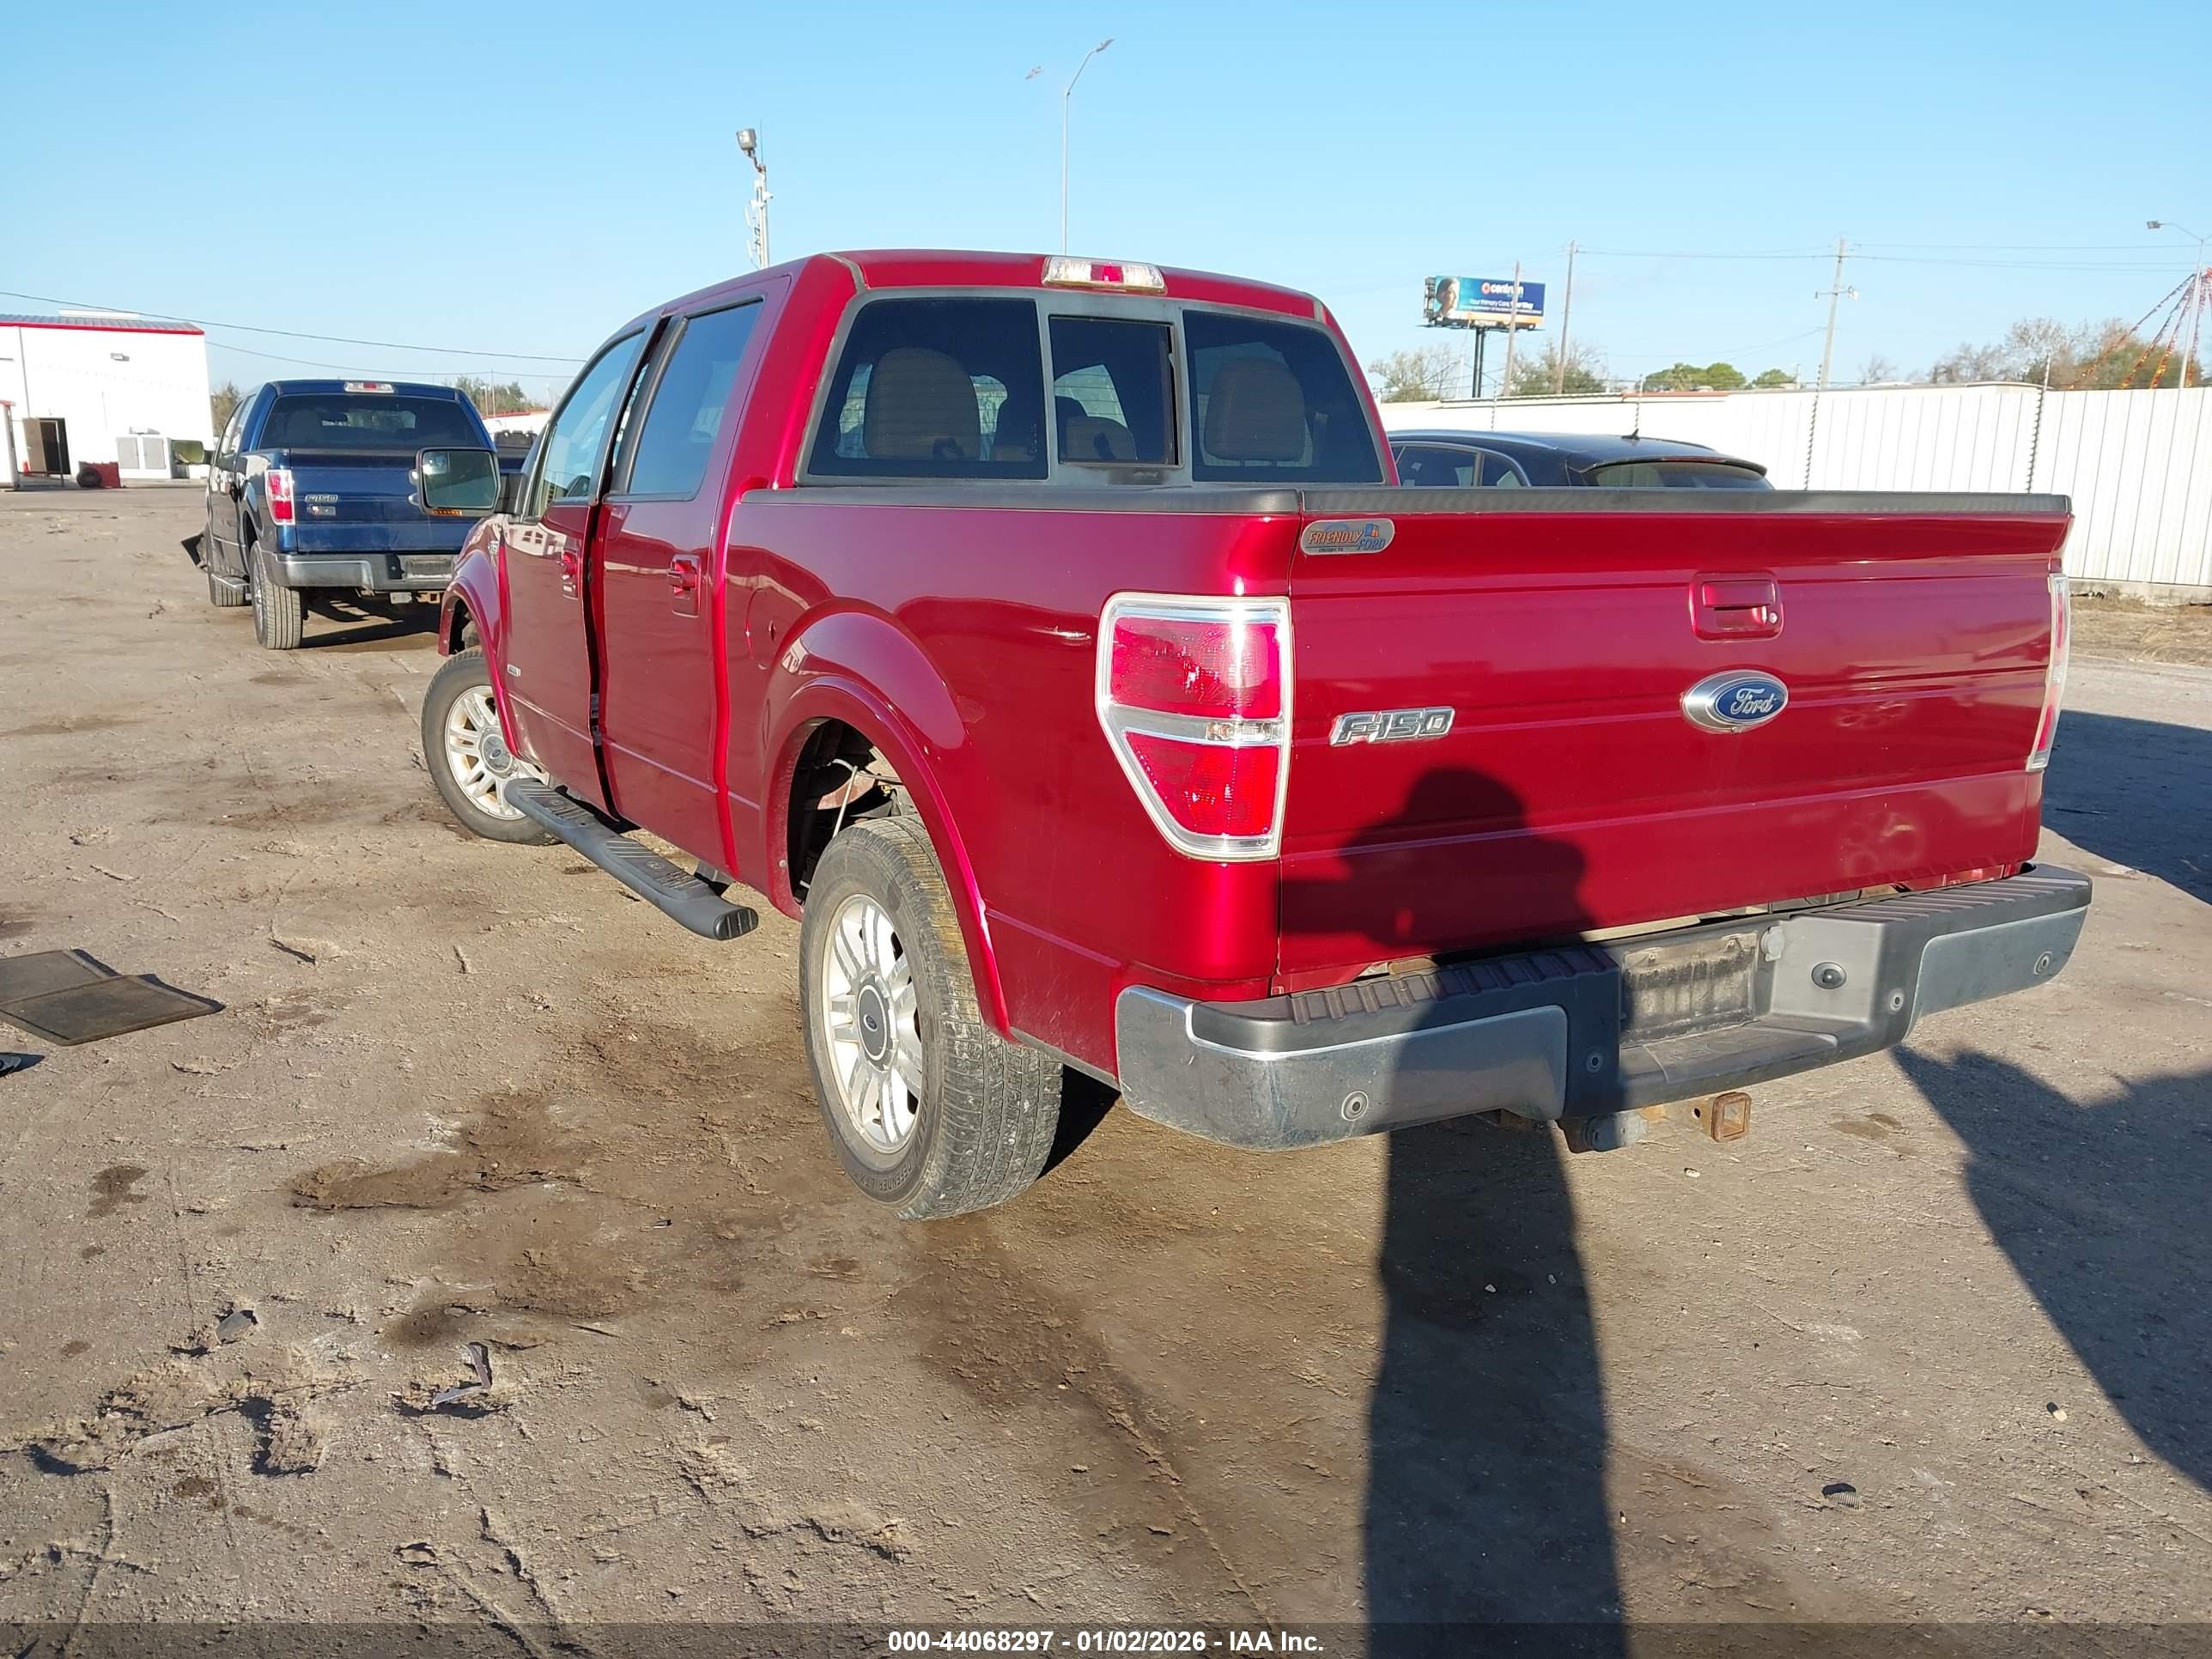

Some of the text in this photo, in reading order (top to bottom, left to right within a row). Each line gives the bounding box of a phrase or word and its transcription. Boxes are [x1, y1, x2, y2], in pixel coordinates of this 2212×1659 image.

[1309, 530, 1364, 544] FRIENDLY
[1358, 538, 1386, 550] FORD
[1730, 688, 1775, 714] Ford
[1330, 706, 1455, 746] F-150
[878, 1160, 914, 1192] DEFENDER
